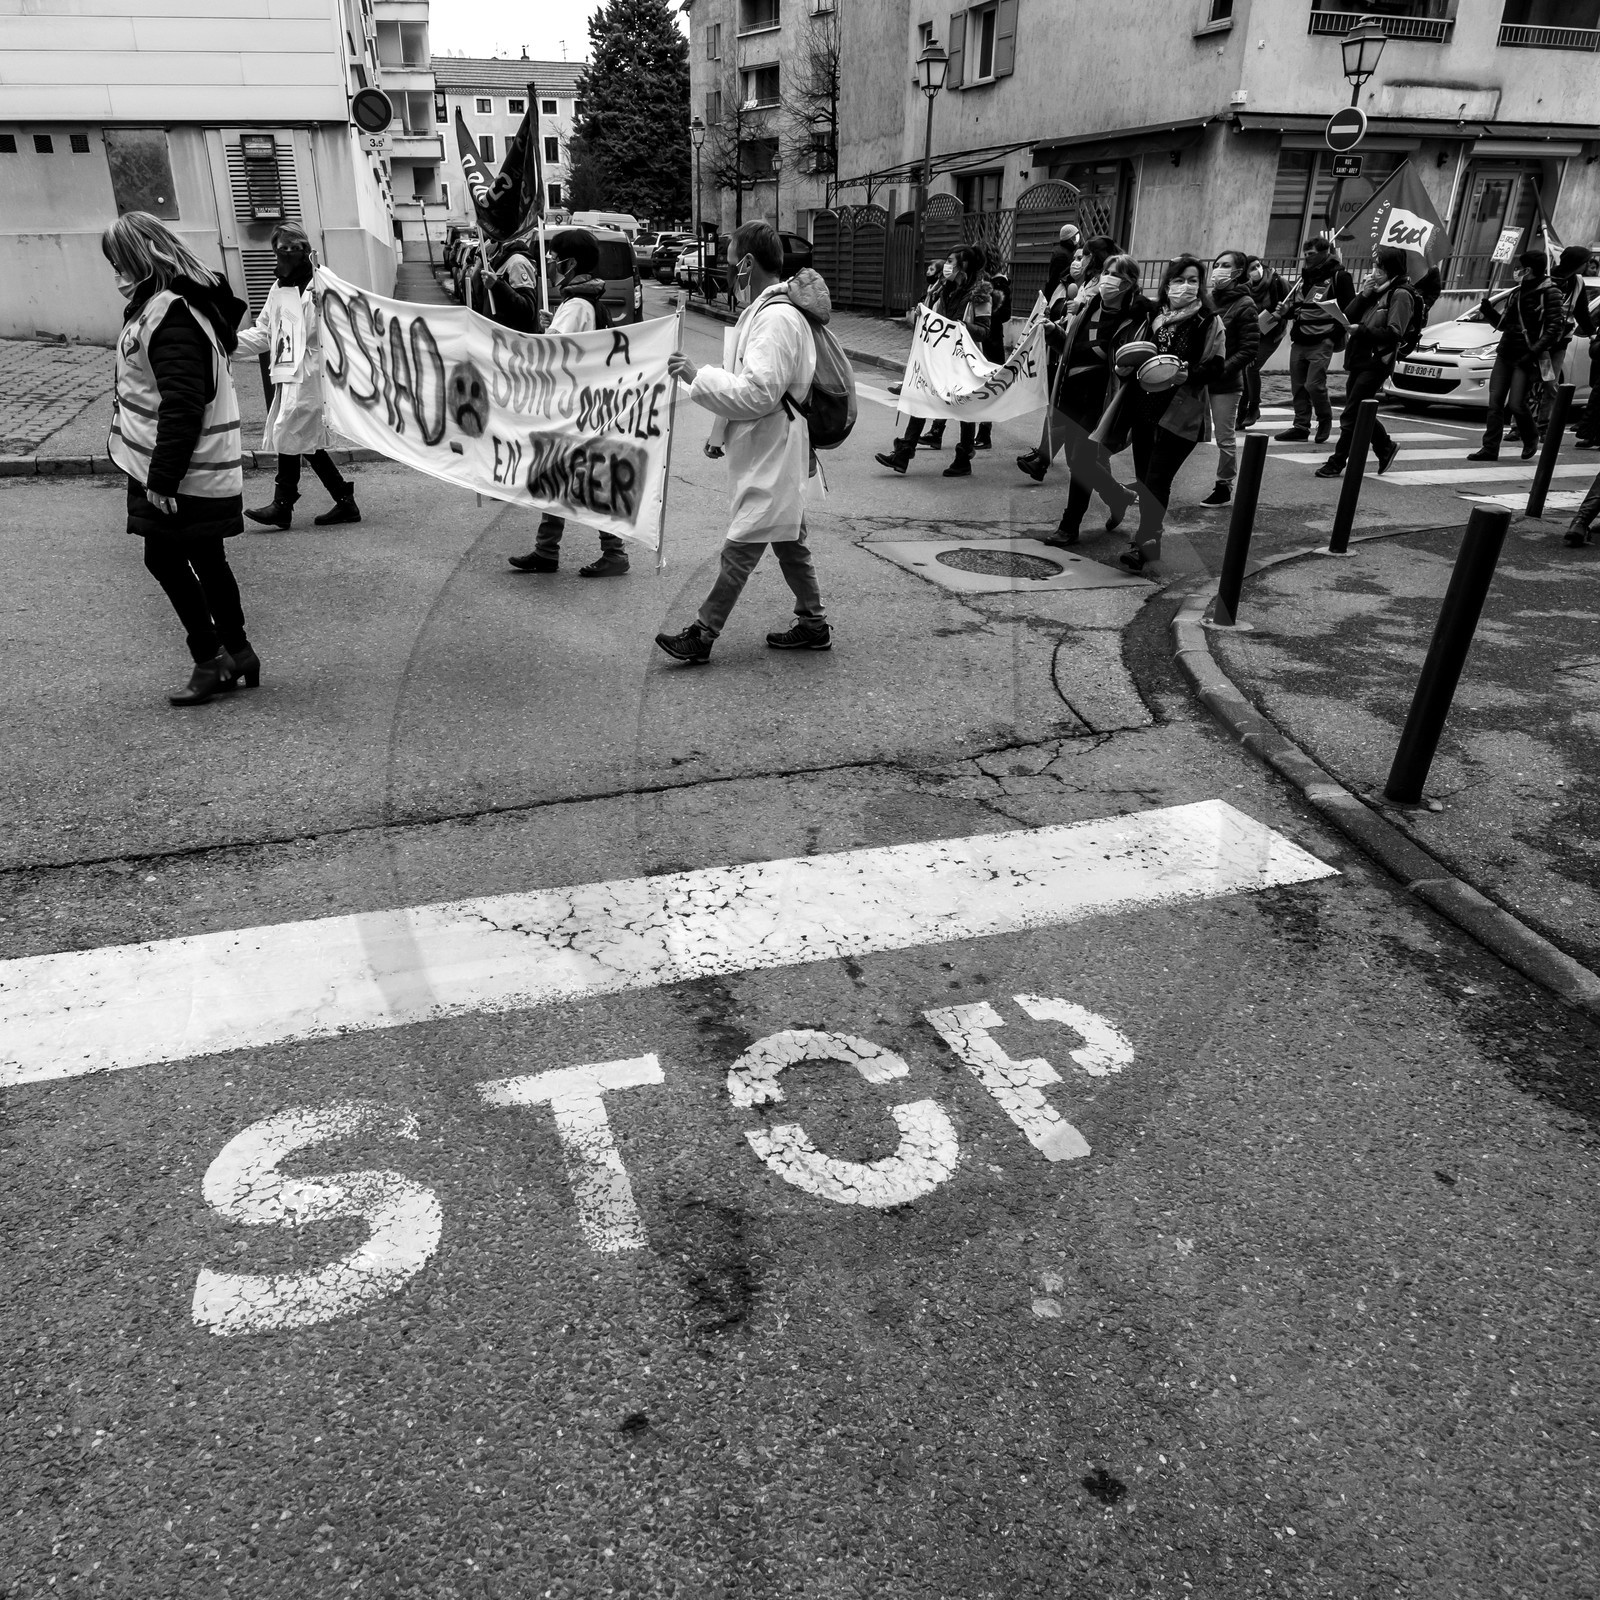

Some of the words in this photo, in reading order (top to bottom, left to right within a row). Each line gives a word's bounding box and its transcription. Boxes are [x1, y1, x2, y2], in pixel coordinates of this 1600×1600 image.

[605, 330, 631, 367] A
[919, 312, 957, 348] APF
[492, 435, 522, 486] EN
[192, 993, 1136, 1337] STOP
